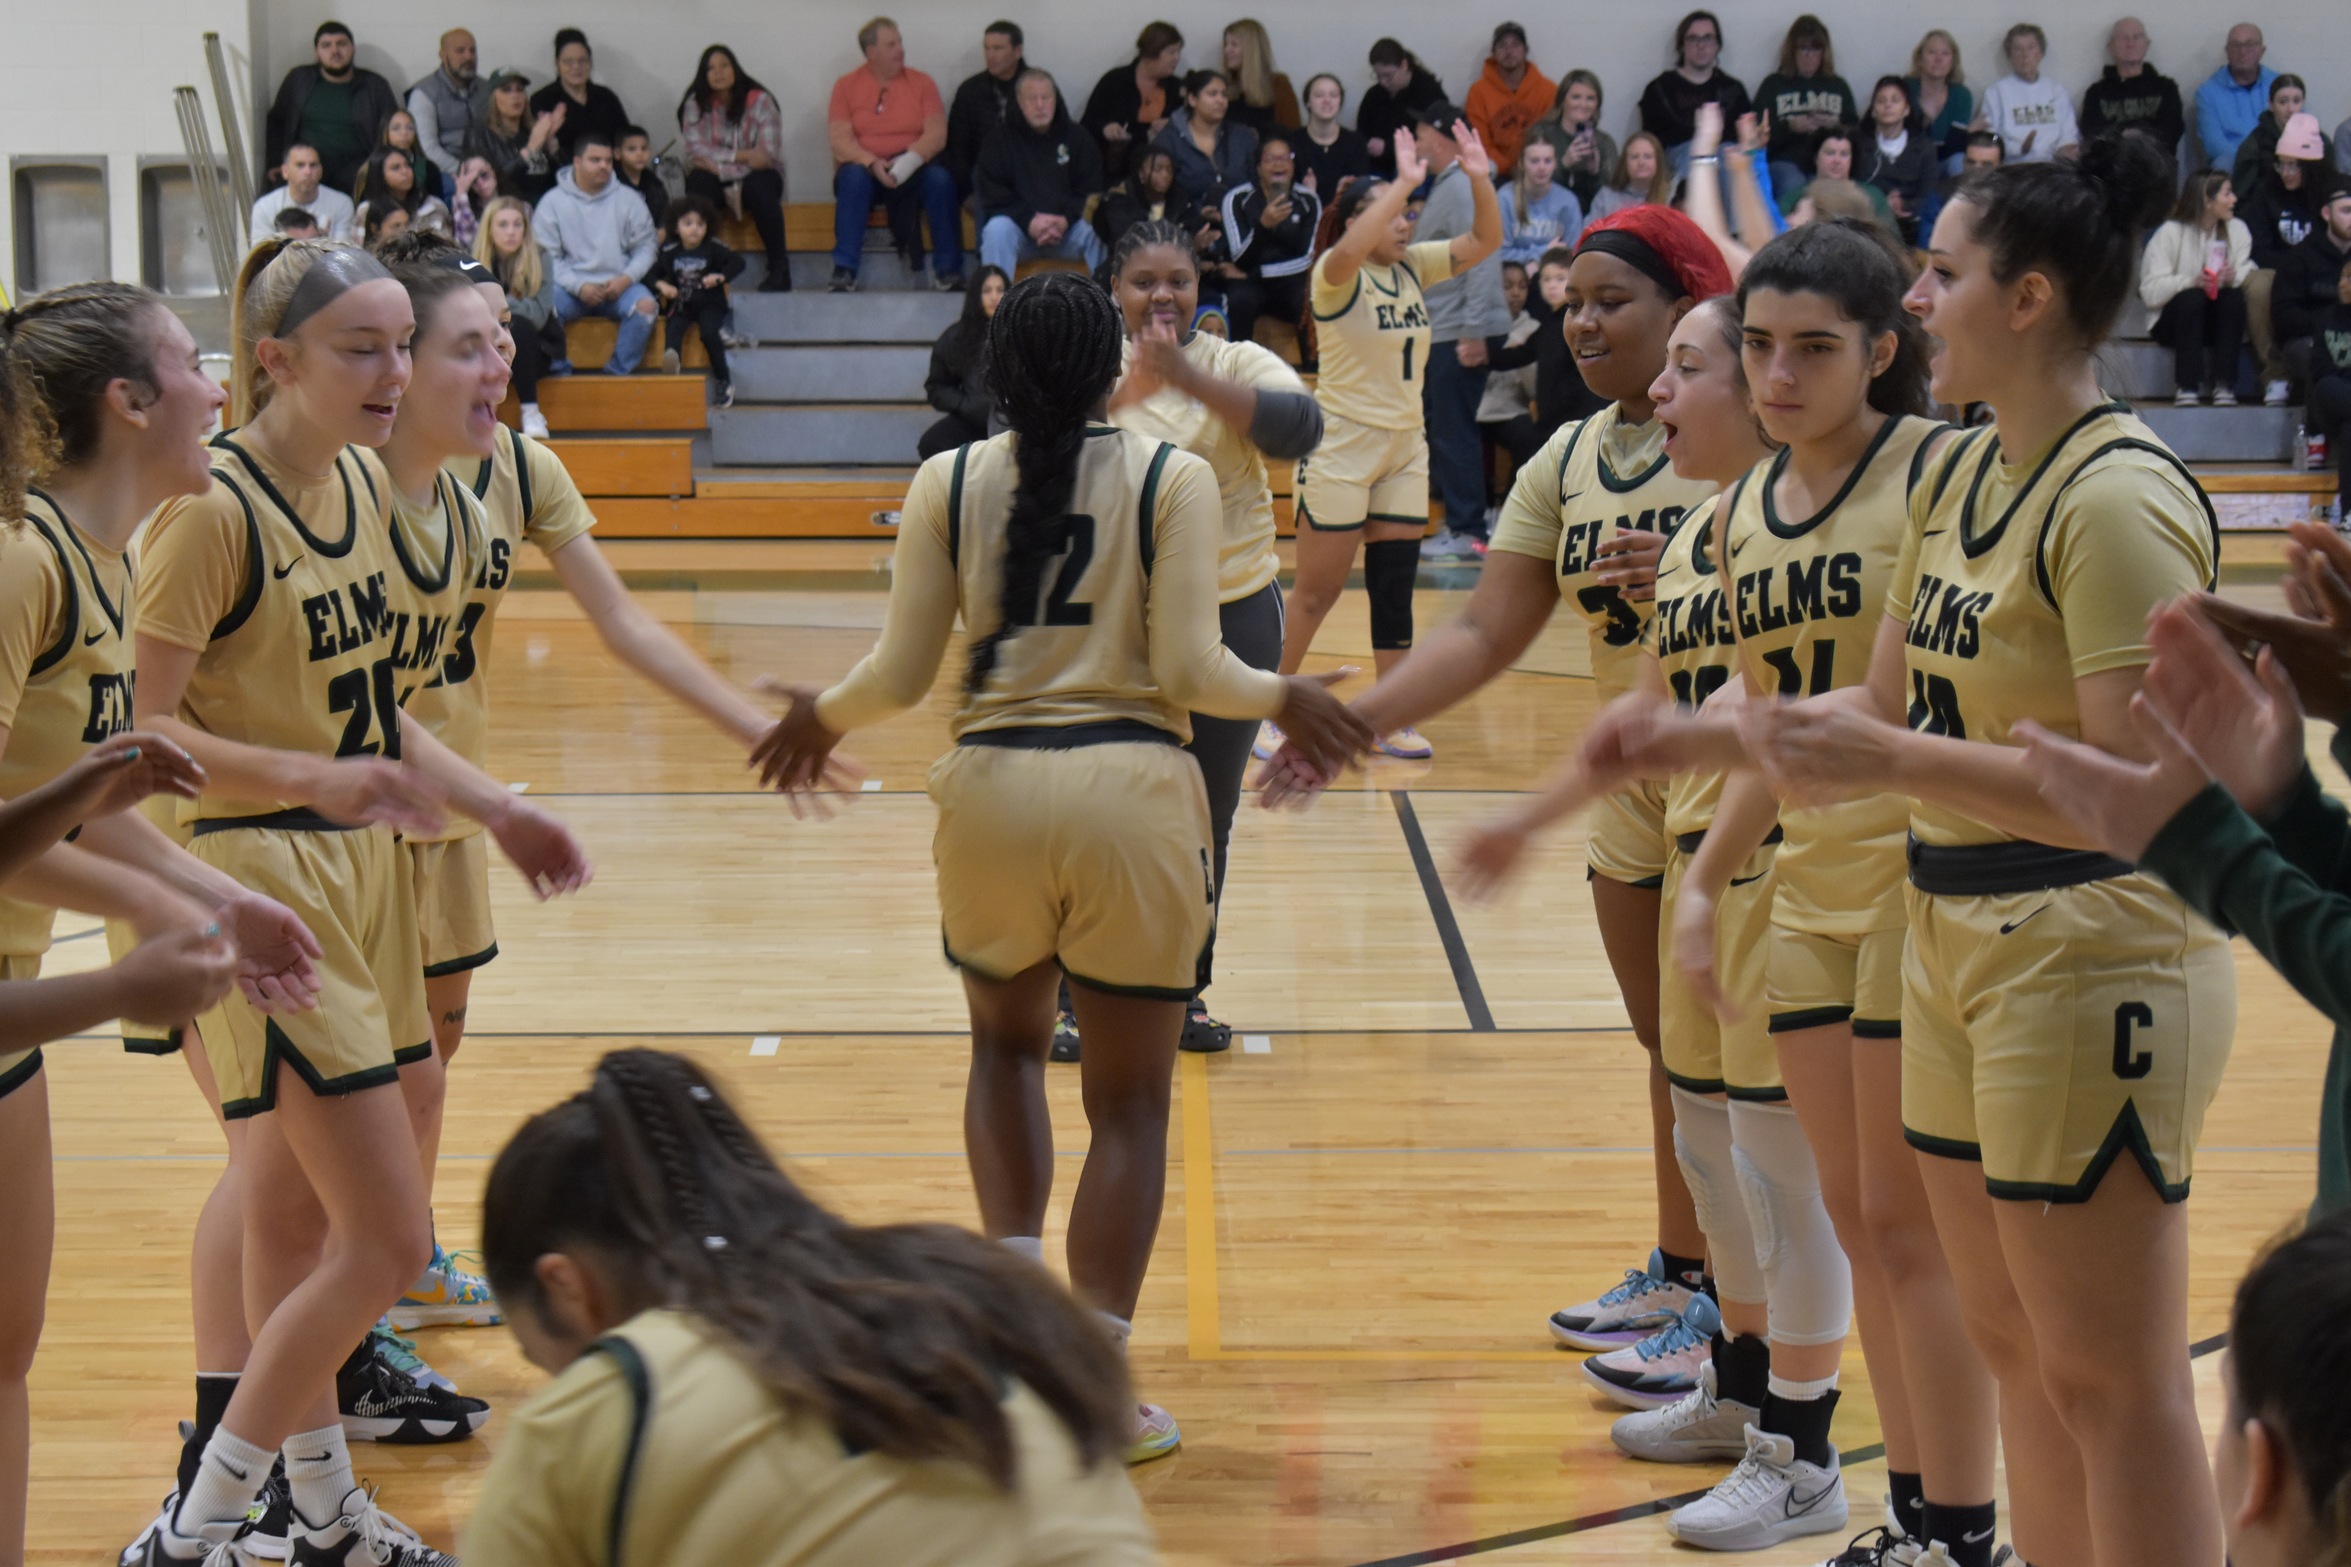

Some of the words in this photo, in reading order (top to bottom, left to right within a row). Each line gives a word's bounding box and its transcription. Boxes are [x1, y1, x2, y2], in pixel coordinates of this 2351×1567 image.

[1776, 91, 1842, 116] ELMS
[1402, 336, 1415, 381] 1
[302, 570, 387, 662] ELM
[1737, 552, 1862, 639] ELMS
[1905, 573, 1994, 660] ELMS
[81, 670, 136, 744] ELM
[2112, 1001, 2154, 1080] C
